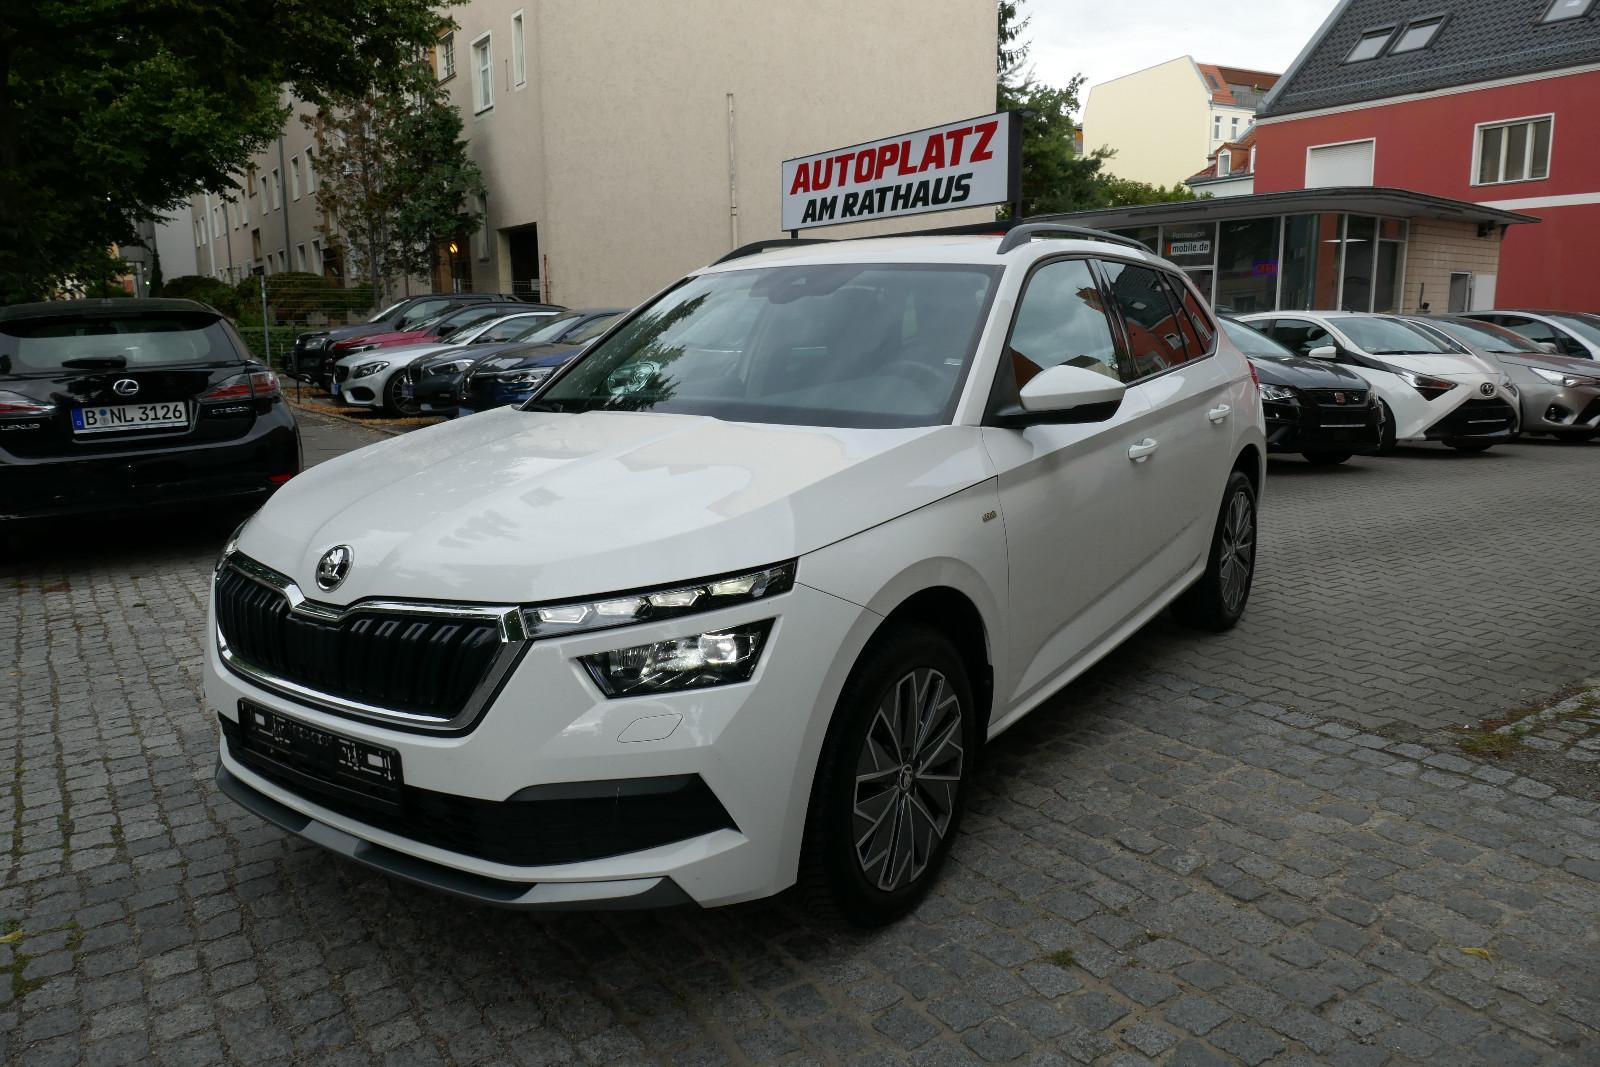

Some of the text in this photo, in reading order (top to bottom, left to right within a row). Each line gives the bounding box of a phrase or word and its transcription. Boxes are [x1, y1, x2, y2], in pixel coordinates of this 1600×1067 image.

[790, 121, 998, 195] AUTOPLATZ
[801, 172, 974, 224] AM RATHAUS
[1172, 242, 1209, 253] mobile.de
[84, 404, 183, 426] B NL 3126
